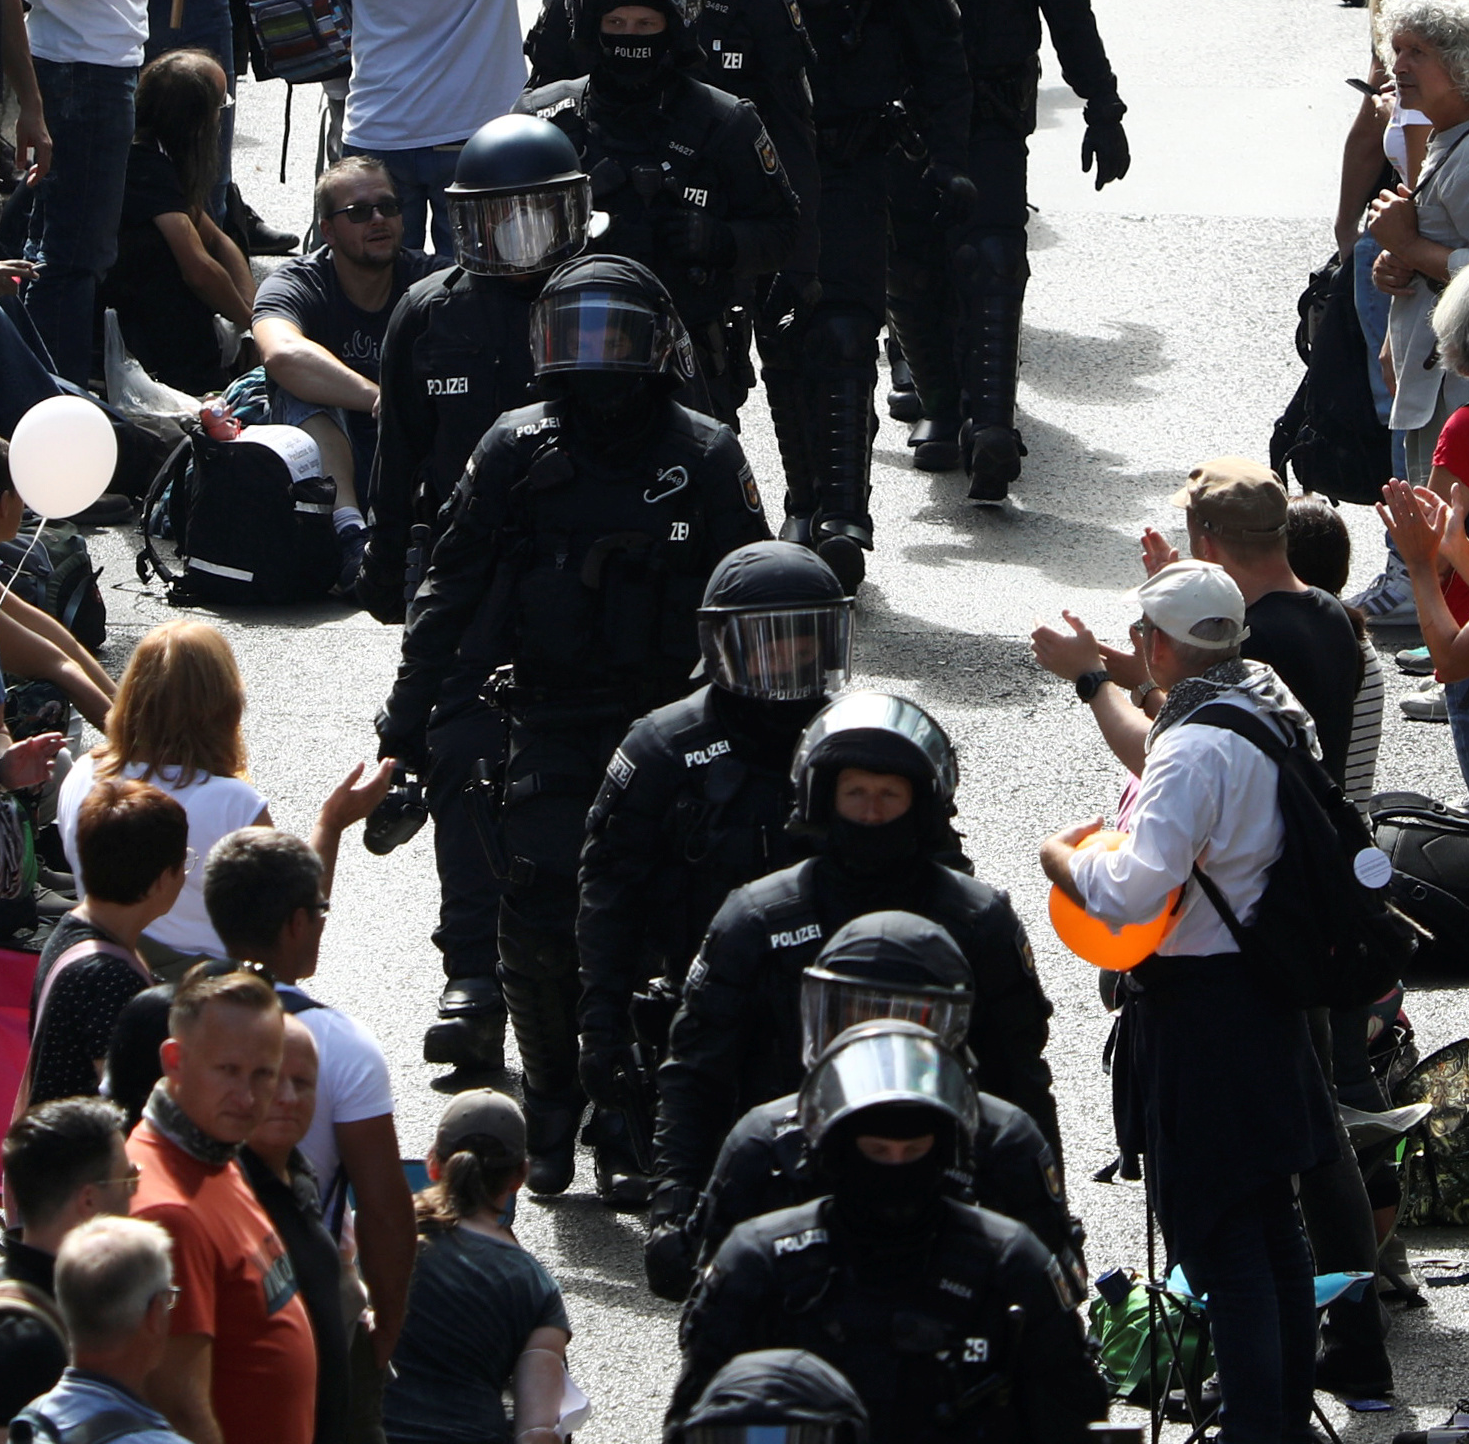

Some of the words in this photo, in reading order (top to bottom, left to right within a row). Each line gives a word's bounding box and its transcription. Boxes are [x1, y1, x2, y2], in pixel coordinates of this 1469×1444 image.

[614, 46, 652, 59] POLIZEI
[537, 97, 576, 120] POLIZEI
[668, 140, 695, 157] 34627
[427, 376, 469, 396] POLIZEI
[516, 416, 561, 438] POLIZEI
[768, 686, 812, 701] POLIZEI
[684, 739, 731, 767] POLIZEI
[770, 923, 823, 949] POLIZEI
[774, 1228, 828, 1256] POLIZEI
